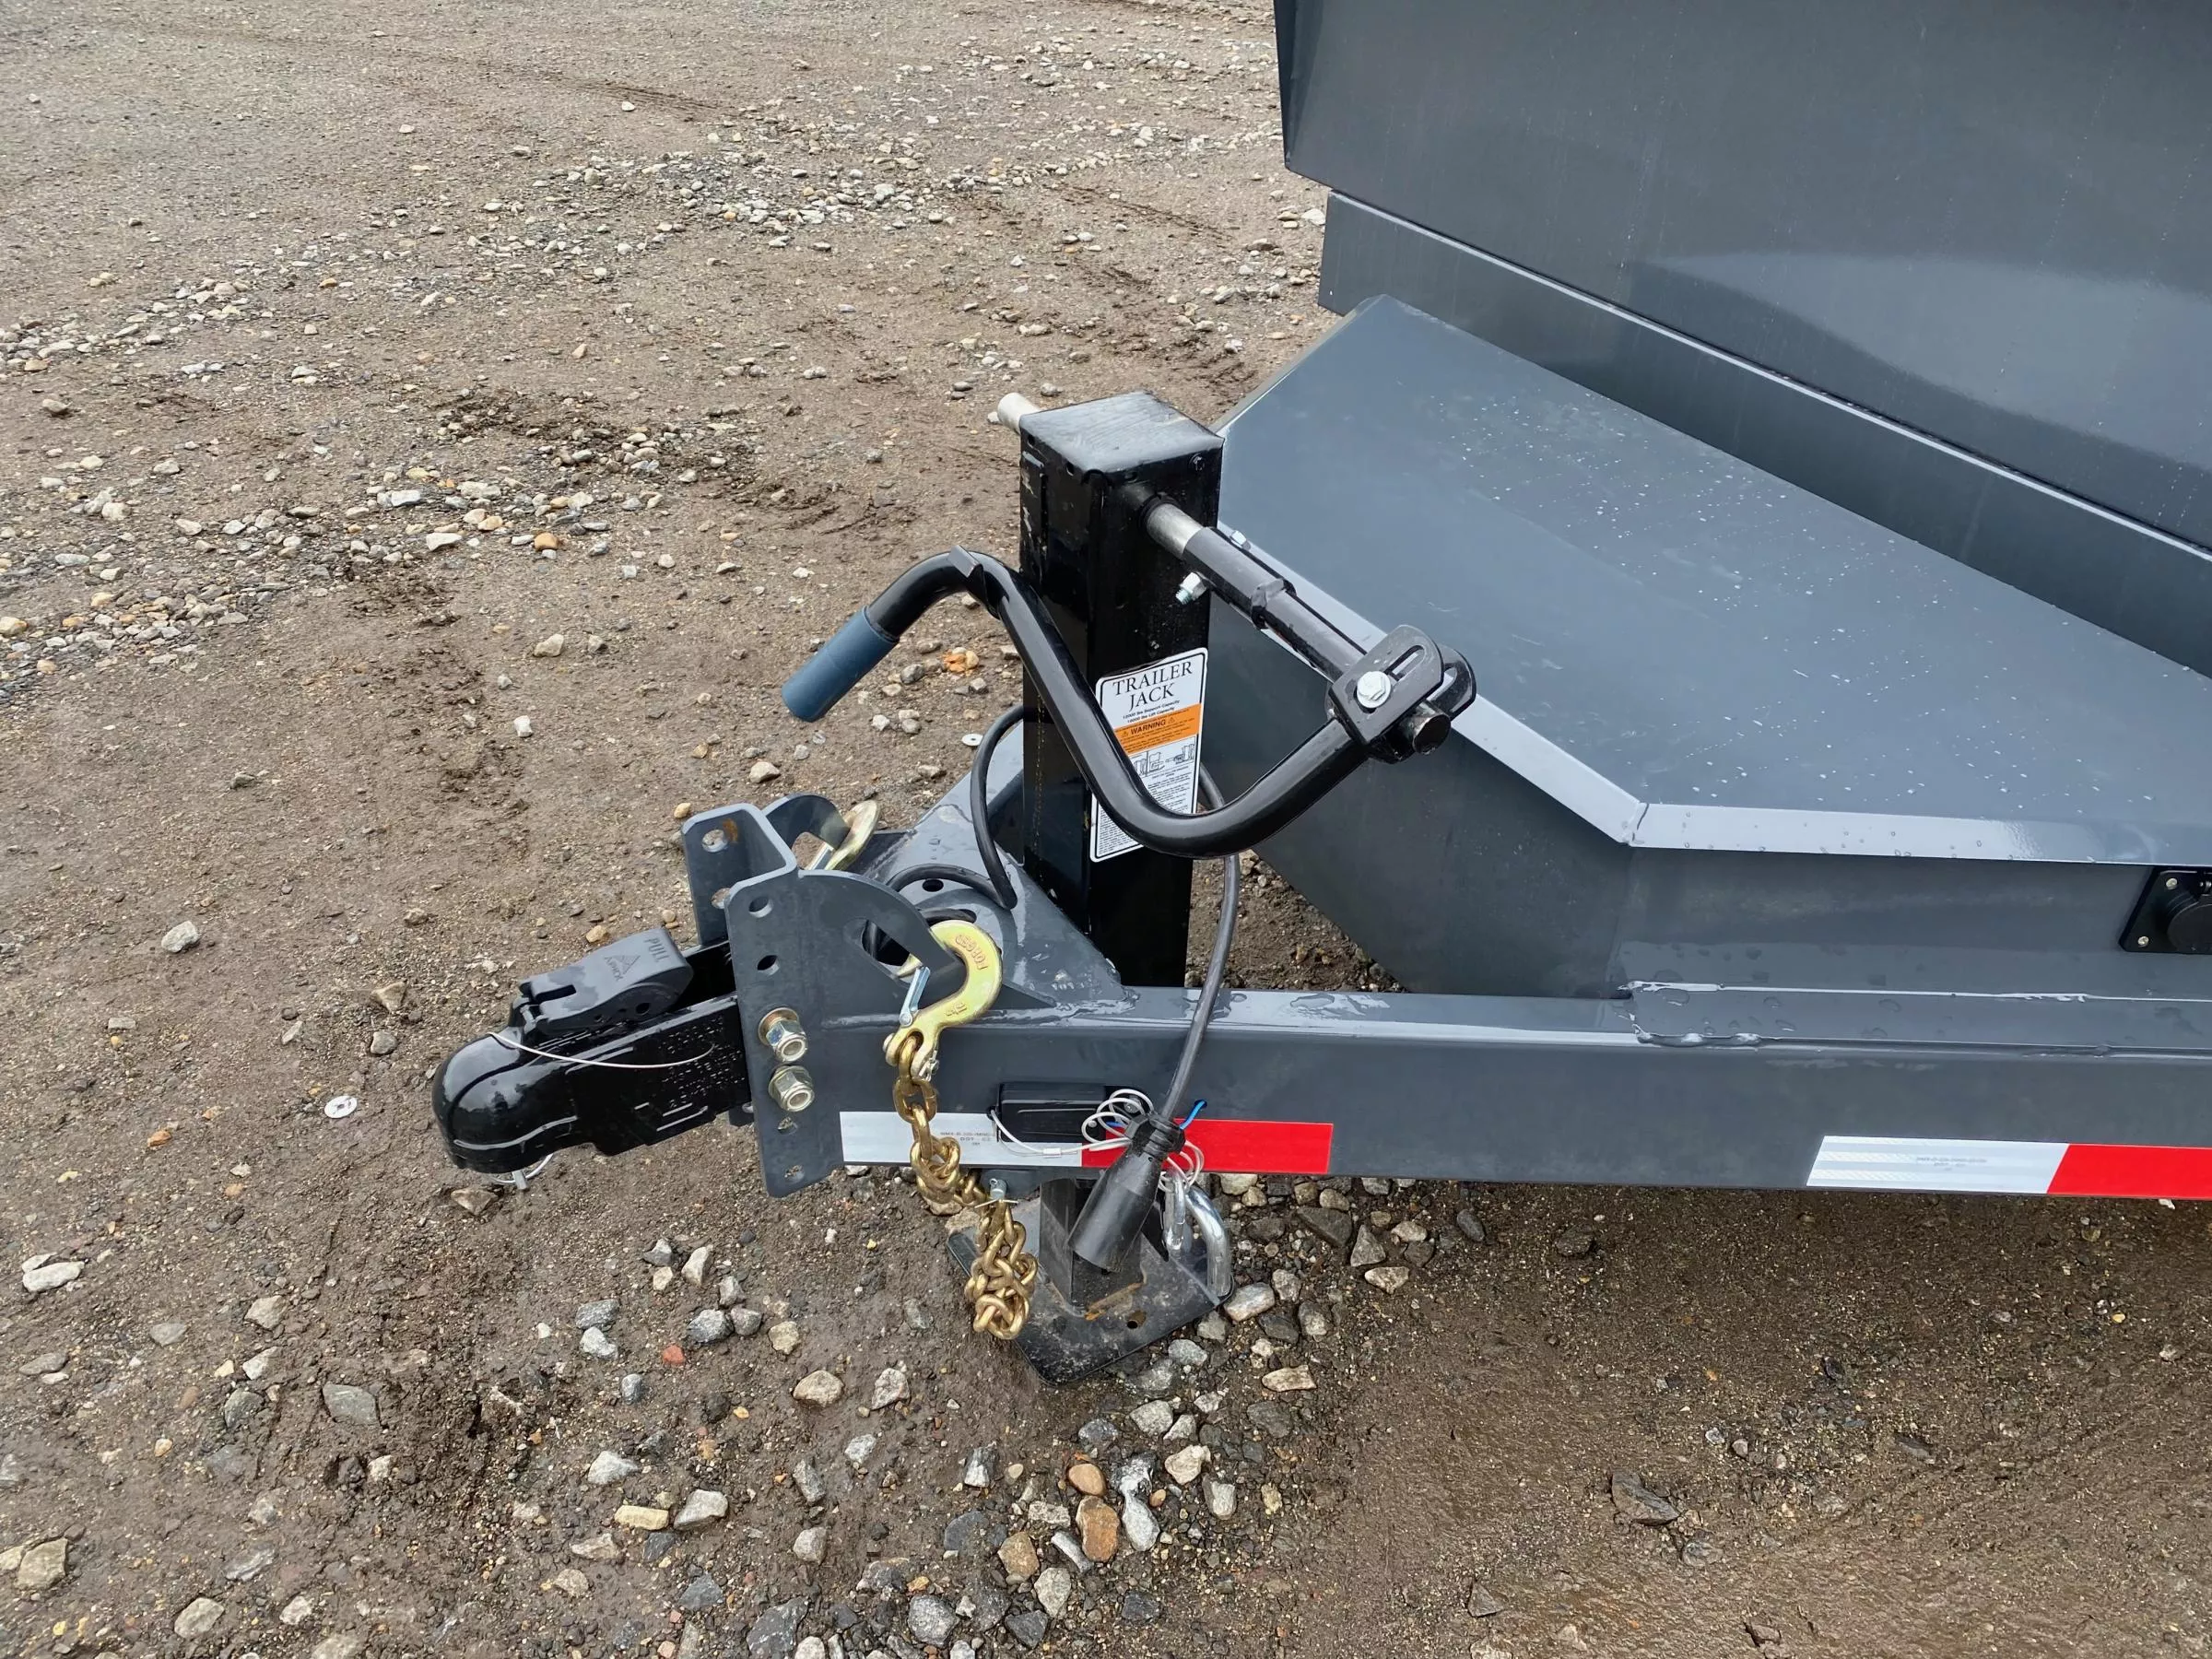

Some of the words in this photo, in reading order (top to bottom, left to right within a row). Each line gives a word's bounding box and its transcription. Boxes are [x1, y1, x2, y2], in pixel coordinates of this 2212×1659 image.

[1112, 661, 1193, 696] TRAILER
[1129, 683, 1174, 712] JACK
[1131, 720, 1166, 735] WARNING
[643, 937, 669, 963] PULL
